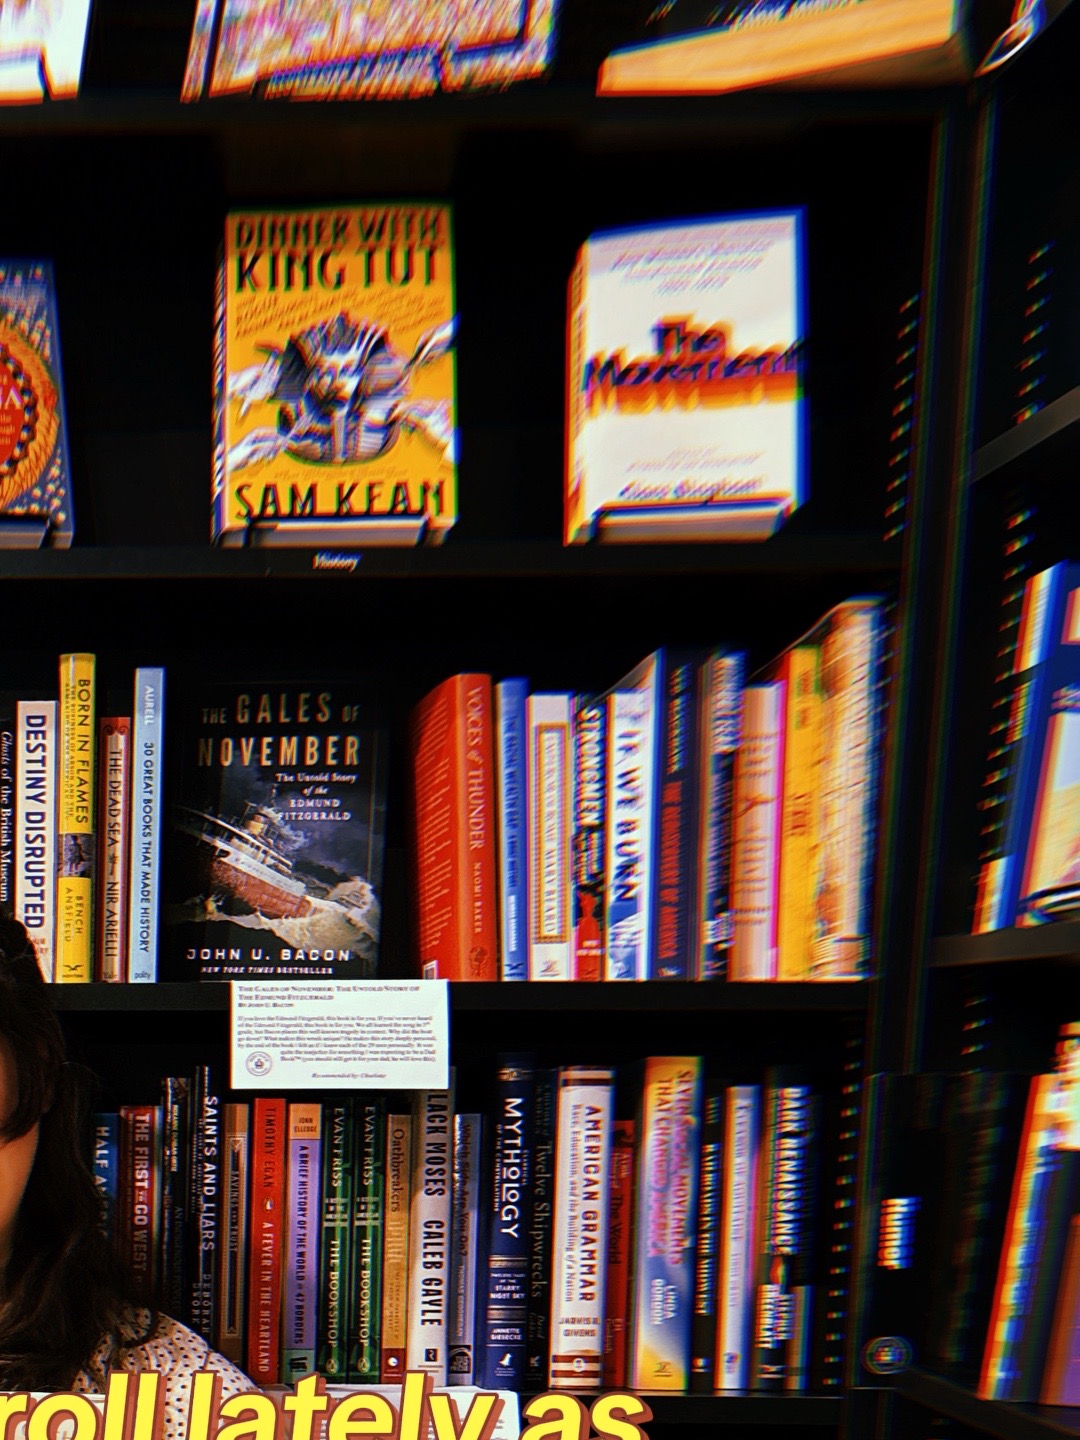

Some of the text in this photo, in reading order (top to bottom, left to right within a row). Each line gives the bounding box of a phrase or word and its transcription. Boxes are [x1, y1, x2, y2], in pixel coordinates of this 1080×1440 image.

[234, 206, 447, 248] DINNER WITH
[235, 245, 441, 292] KING TUT
[234, 481, 446, 519] SAM KEAN
[312, 552, 362, 571] History
[144, 686, 155, 724] AURELL
[201, 693, 361, 724] THE GALES OF
[76, 678, 90, 824] BORN IN FLAMES
[198, 736, 361, 766] NOVEMBER
[108, 749, 122, 847] THE DEAD SEA
[275, 773, 358, 784] The Untold Story
[303, 786, 328, 796] of the
[0, 731, 13, 902] Ghosts of the British Museum
[24, 715, 46, 928] DESTINY DISRUPTED
[278, 811, 351, 820] FITZGERALD
[290, 799, 340, 808] EDMUND
[140, 742, 154, 952] 30 GREAT BOOKS THAT MADE HISTORY
[105, 882, 119, 957] NIR ARIELLI
[187, 949, 351, 962] JOHN U. BACON
[264, 1108, 275, 1188] TIMOTHY EGAN
[362, 1106, 375, 1186] EVAN FRISS
[424, 1094, 449, 1197] LACK MOSES
[202, 1096, 218, 1251] SAINTS AND LIARS
[298, 1154, 308, 1179] BRIEF
[391, 1128, 405, 1213] Oathbreakers
[500, 1097, 523, 1239] MYTHOLOGY
[297, 1181, 307, 1219] HISTORY
[529, 1141, 551, 1298] Twelve Shipwrecks
[579, 1106, 601, 1302] AMERICAN GRAMMAR
[296, 1233, 307, 1249] THE
[297, 1221, 307, 1231] OF
[261, 1233, 271, 1266] FEVER
[296, 1251, 306, 1281] WORLD
[260, 1270, 271, 1282] IN
[358, 1237, 372, 1347] THE BOOKSHOP
[421, 1220, 444, 1326] CALEB GAYLE
[260, 1286, 271, 1306] THE
[296, 1292, 305, 1304] 47
[258, 1310, 270, 1372] HEARTLAND
[294, 1305, 304, 1344] BORDERS
